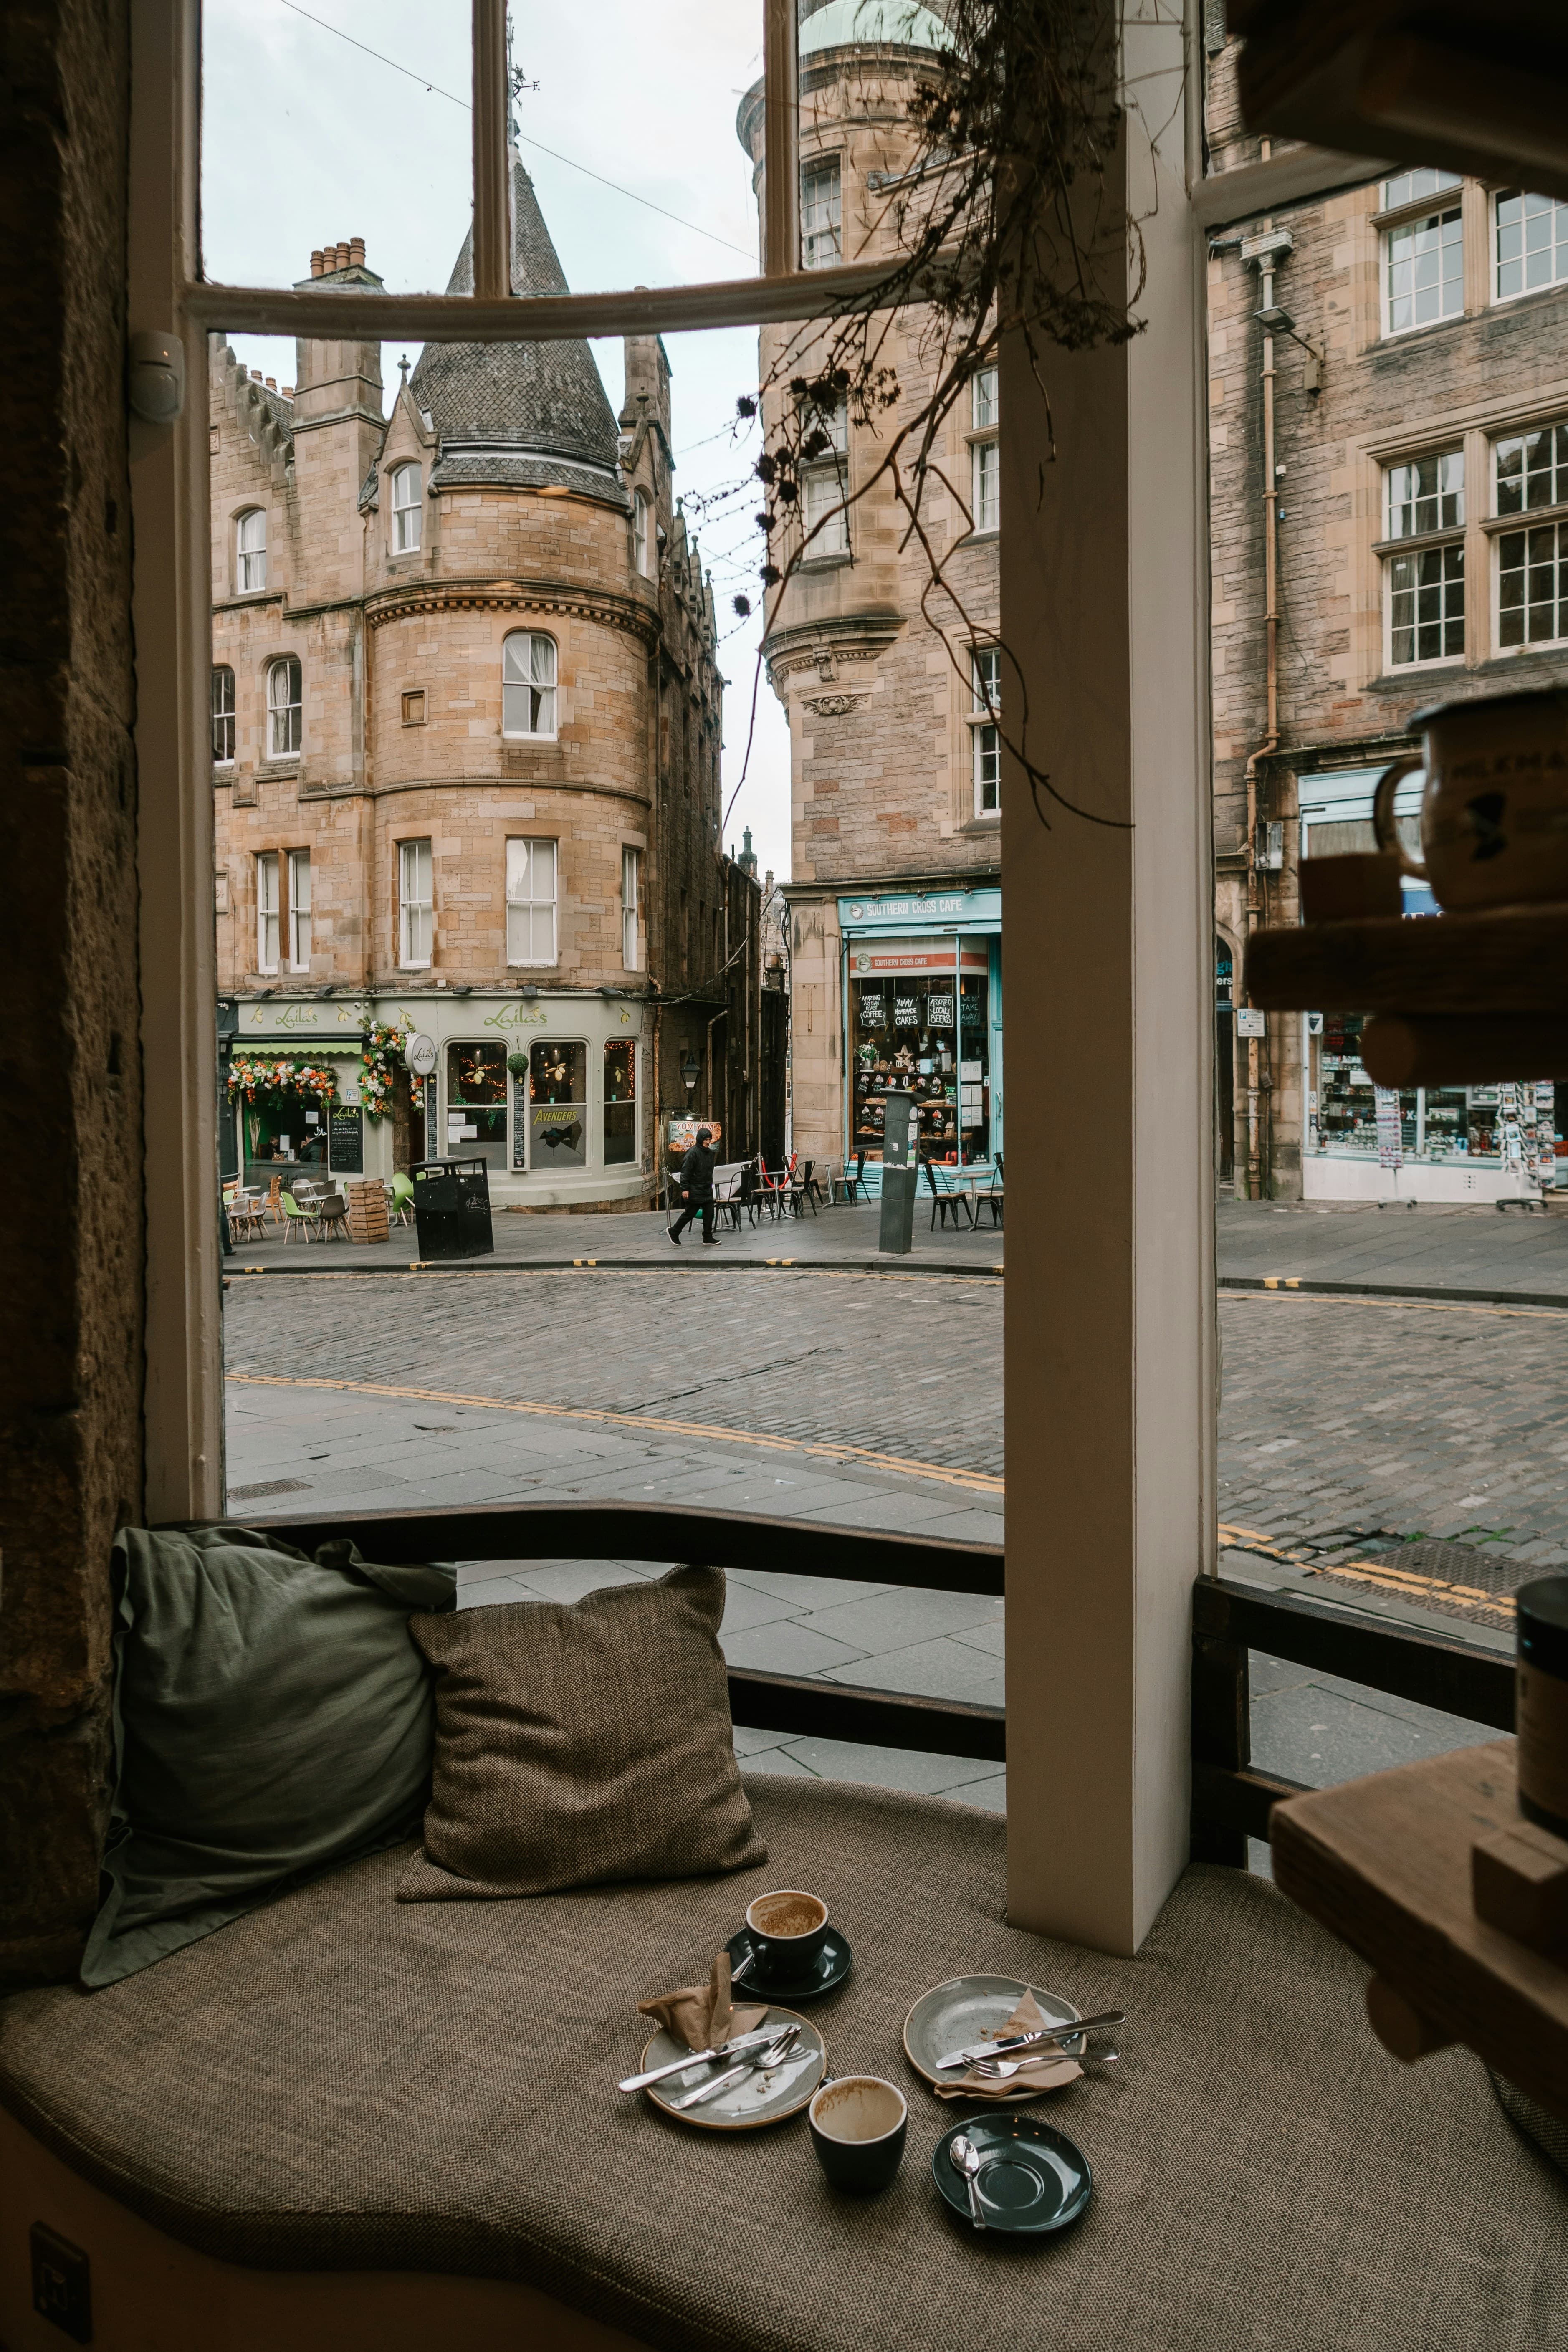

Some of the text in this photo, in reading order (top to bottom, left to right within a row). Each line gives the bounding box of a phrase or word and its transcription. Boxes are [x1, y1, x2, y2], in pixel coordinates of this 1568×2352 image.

[867, 899, 962, 916] SOUTHERN CROSS CAFE
[896, 998, 913, 1007] YUMMY
[929, 998, 951, 1007] ASSORTED
[895, 1007, 917, 1016] HOMEMADE
[961, 1003, 979, 1012] TAKE
[484, 1004, 548, 1030] Laila's
[863, 1010, 883, 1018] COFFEE
[930, 1014, 951, 1023] BEERS
[961, 1012, 977, 1021] AWAY
[895, 1015, 918, 1026] CAKES
[532, 1108, 577, 1126] AVENGERS
